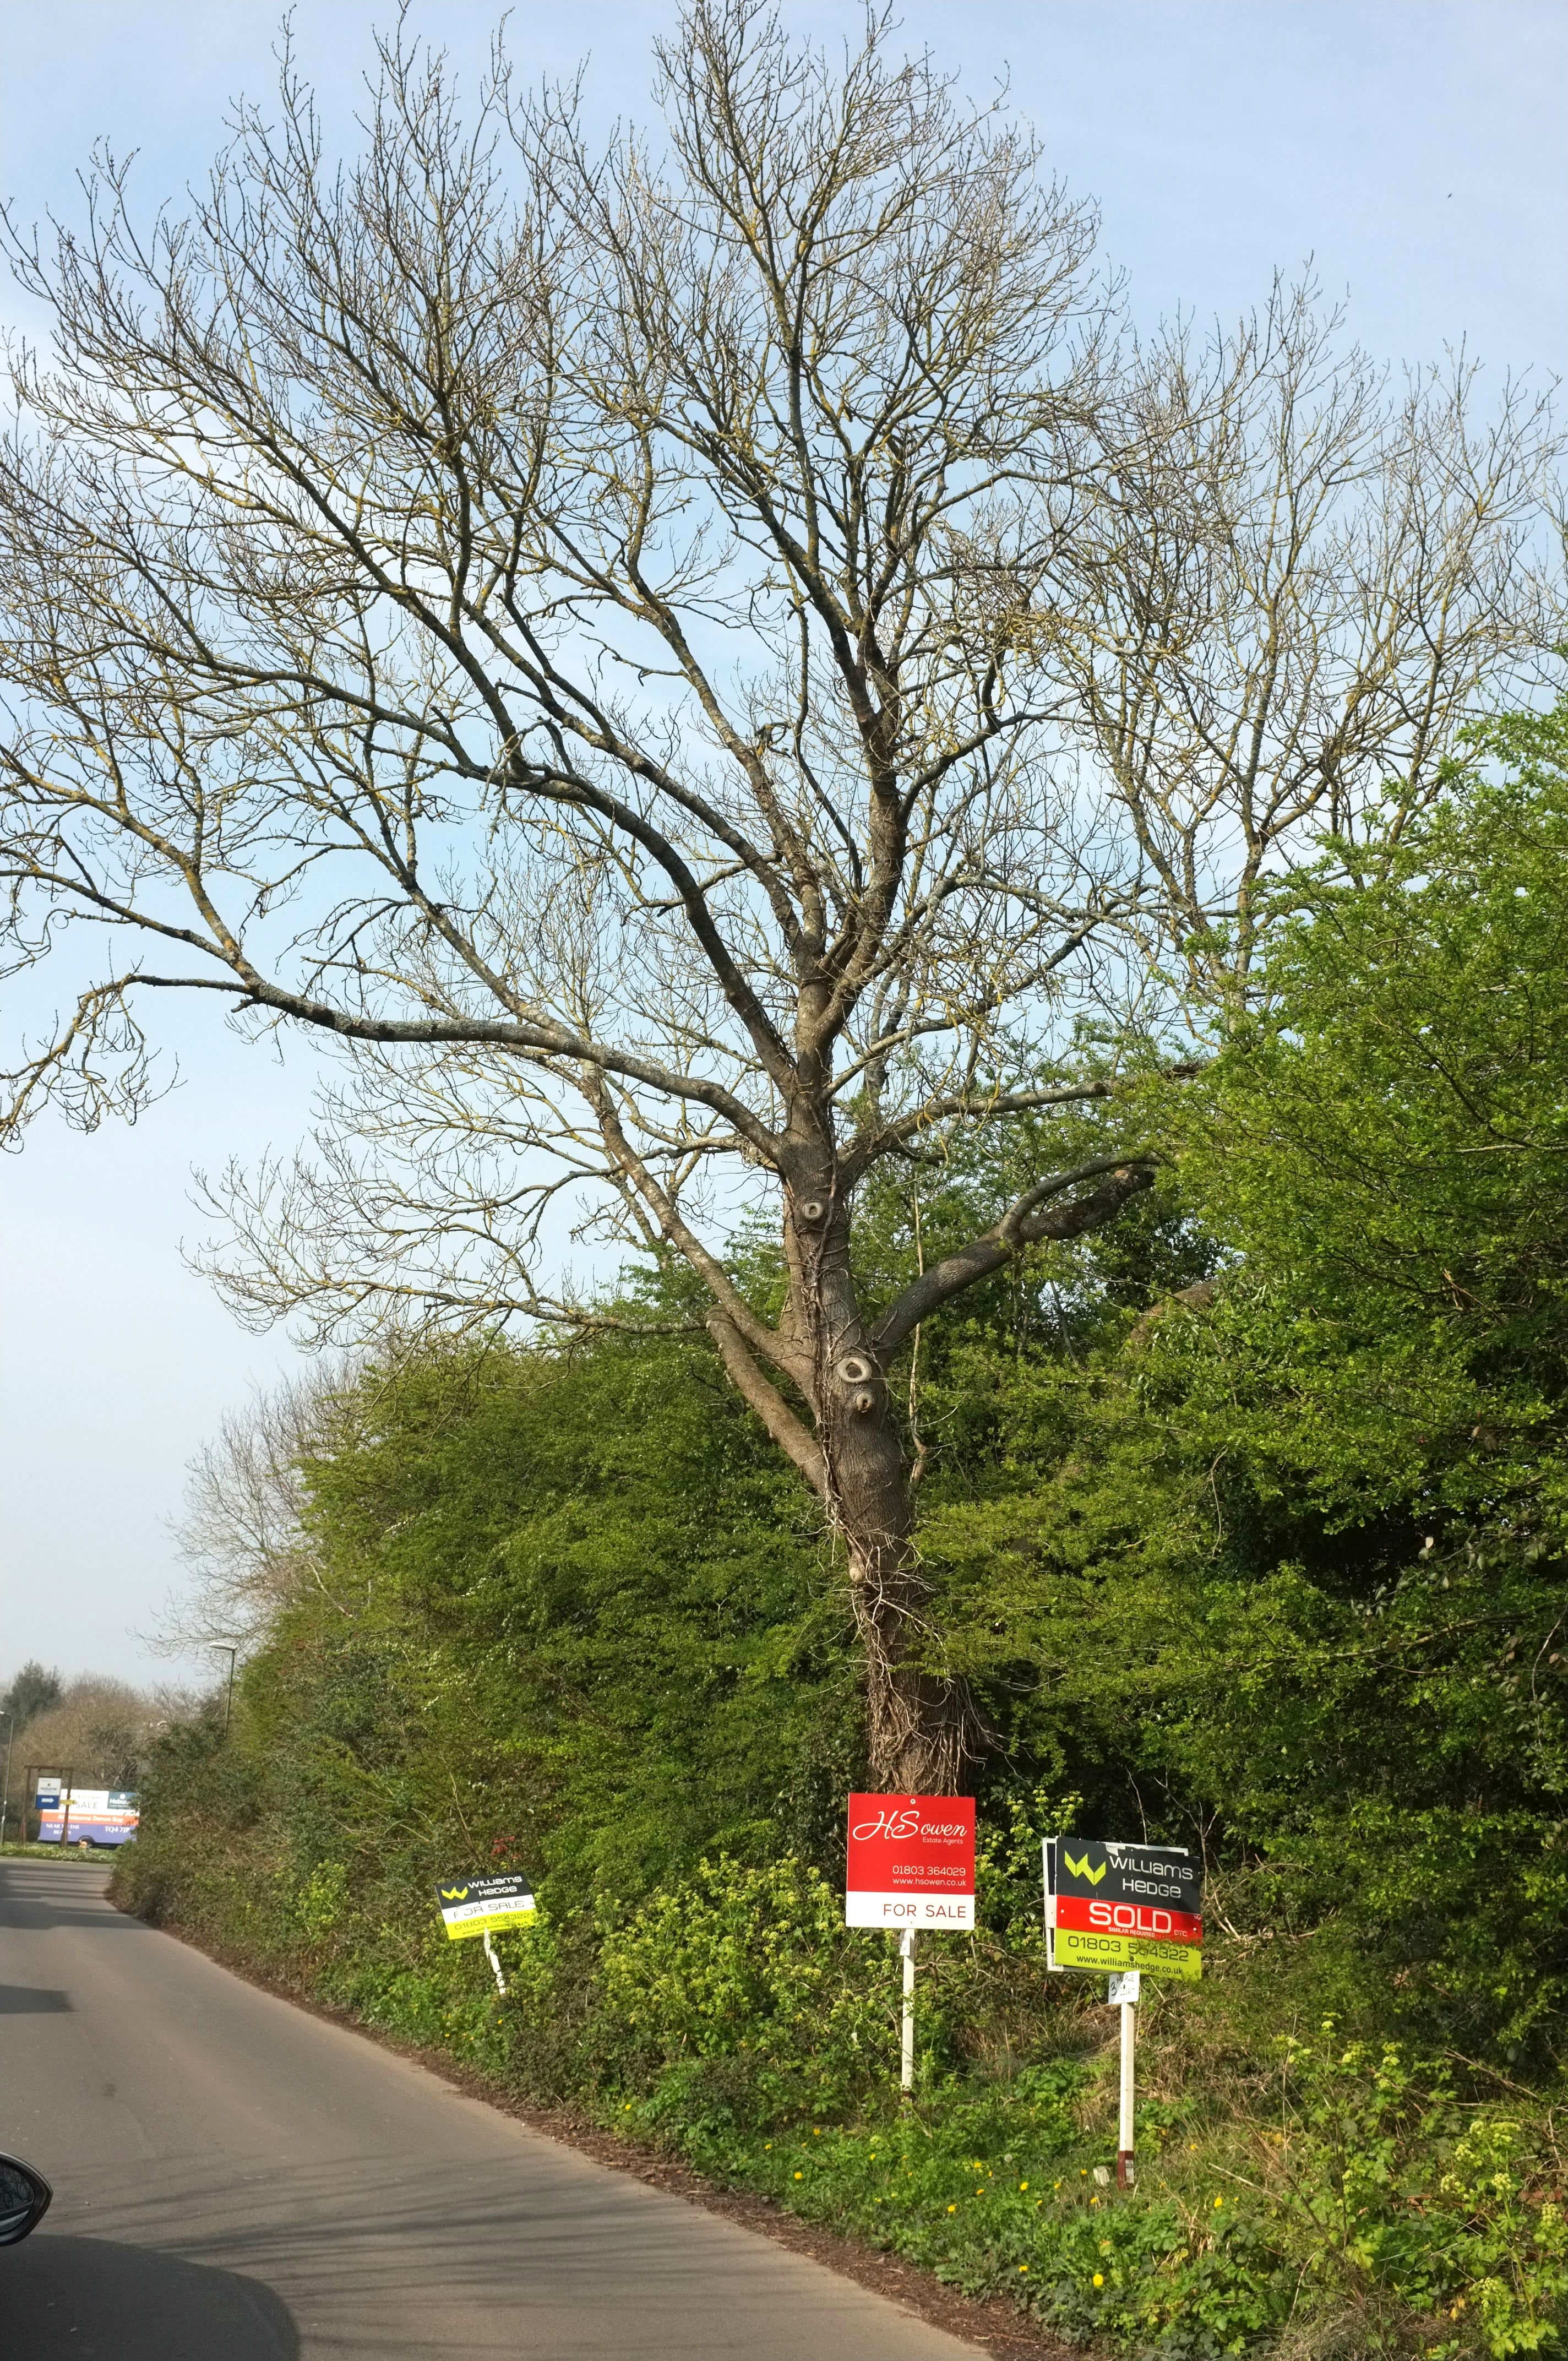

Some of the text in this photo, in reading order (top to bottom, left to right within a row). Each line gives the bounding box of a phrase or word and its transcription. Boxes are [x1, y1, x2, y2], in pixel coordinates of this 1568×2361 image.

[892, 1865, 966, 1876] 01803 364029
[892, 1877, 967, 1886] www.hsowen.co.uk
[488, 1901, 525, 1911] SALE
[883, 1903, 966, 1918] FOR SALE
[455, 1918, 487, 1930] 01803
[1089, 1902, 1172, 1934] SOLD
[1130, 1929, 1155, 1938] REQUIRED
[1068, 1936, 1121, 1952] 01803
[1076, 1955, 1183, 1975] www.williamshedge.co.uk
